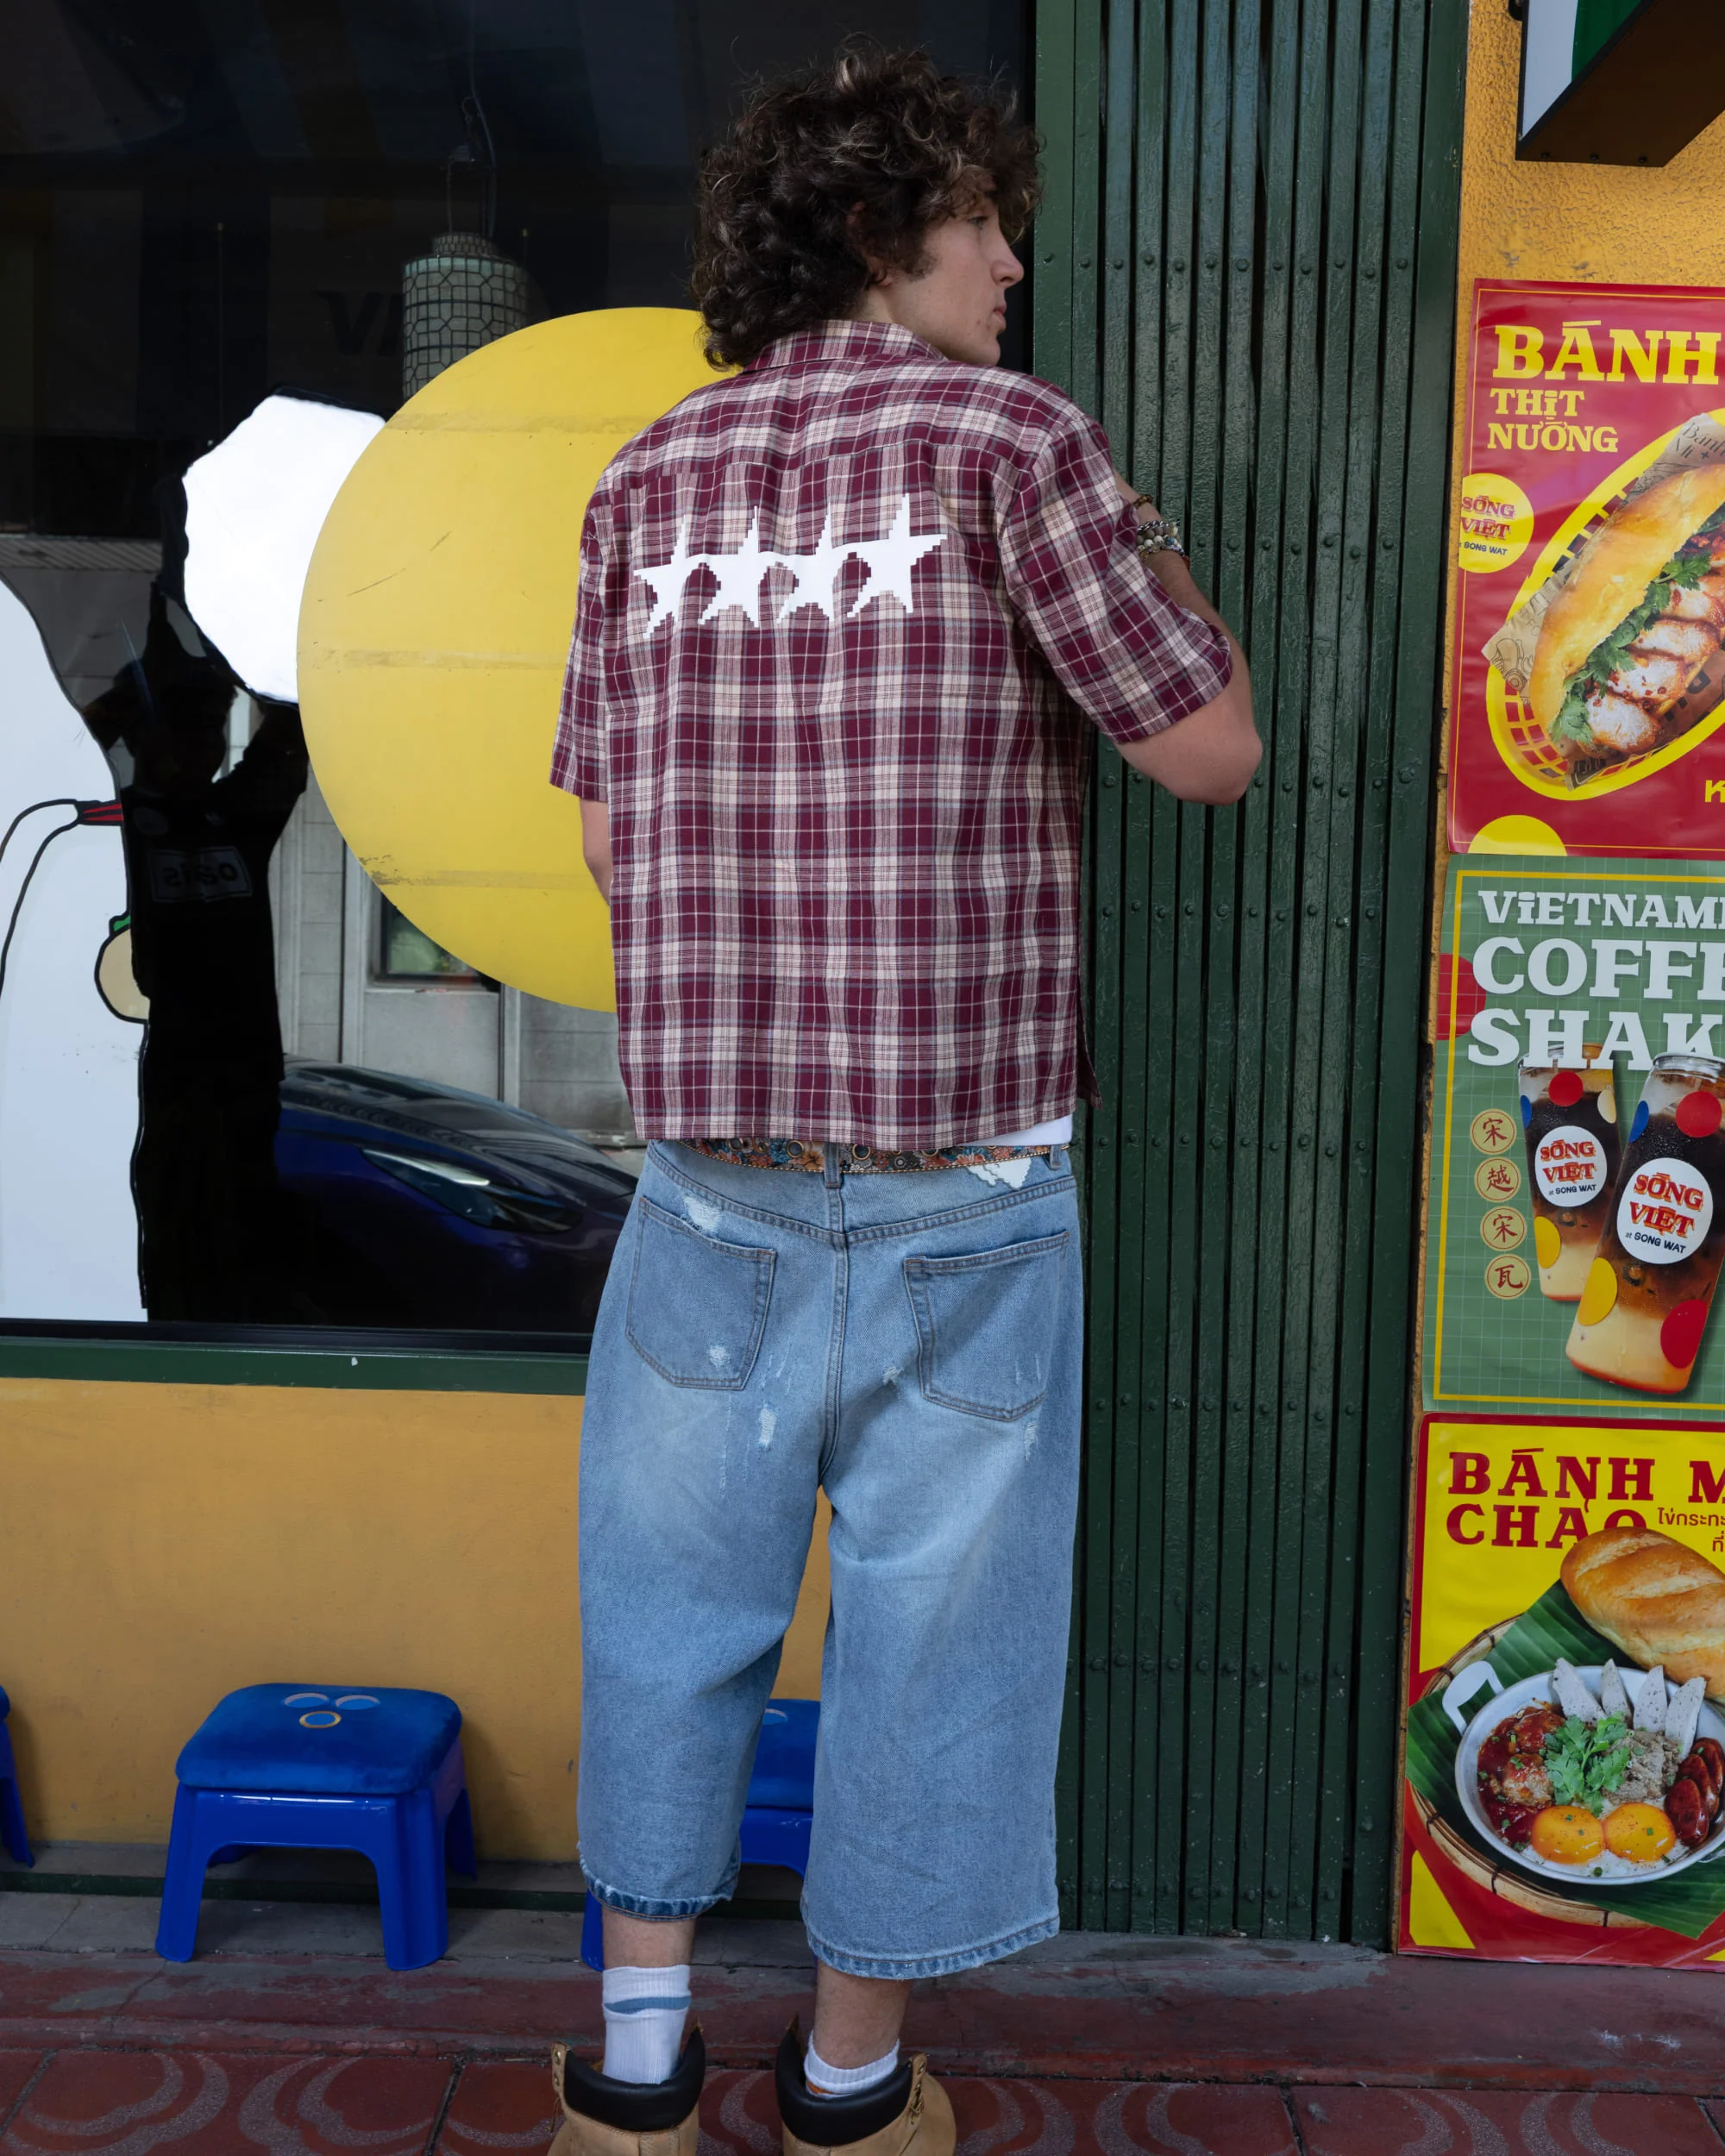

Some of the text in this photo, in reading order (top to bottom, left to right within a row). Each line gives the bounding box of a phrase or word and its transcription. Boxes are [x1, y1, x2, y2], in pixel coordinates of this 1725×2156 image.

[1464, 542, 1487, 552] SONG
[1489, 545, 1509, 556] WAT
[1478, 890, 1725, 930] ViETNAM
[1483, 1118, 1523, 1288] 宋 越 宋 瓦
[1634, 1232, 1661, 1247] SONG
[1664, 1240, 1686, 1254] WAT
